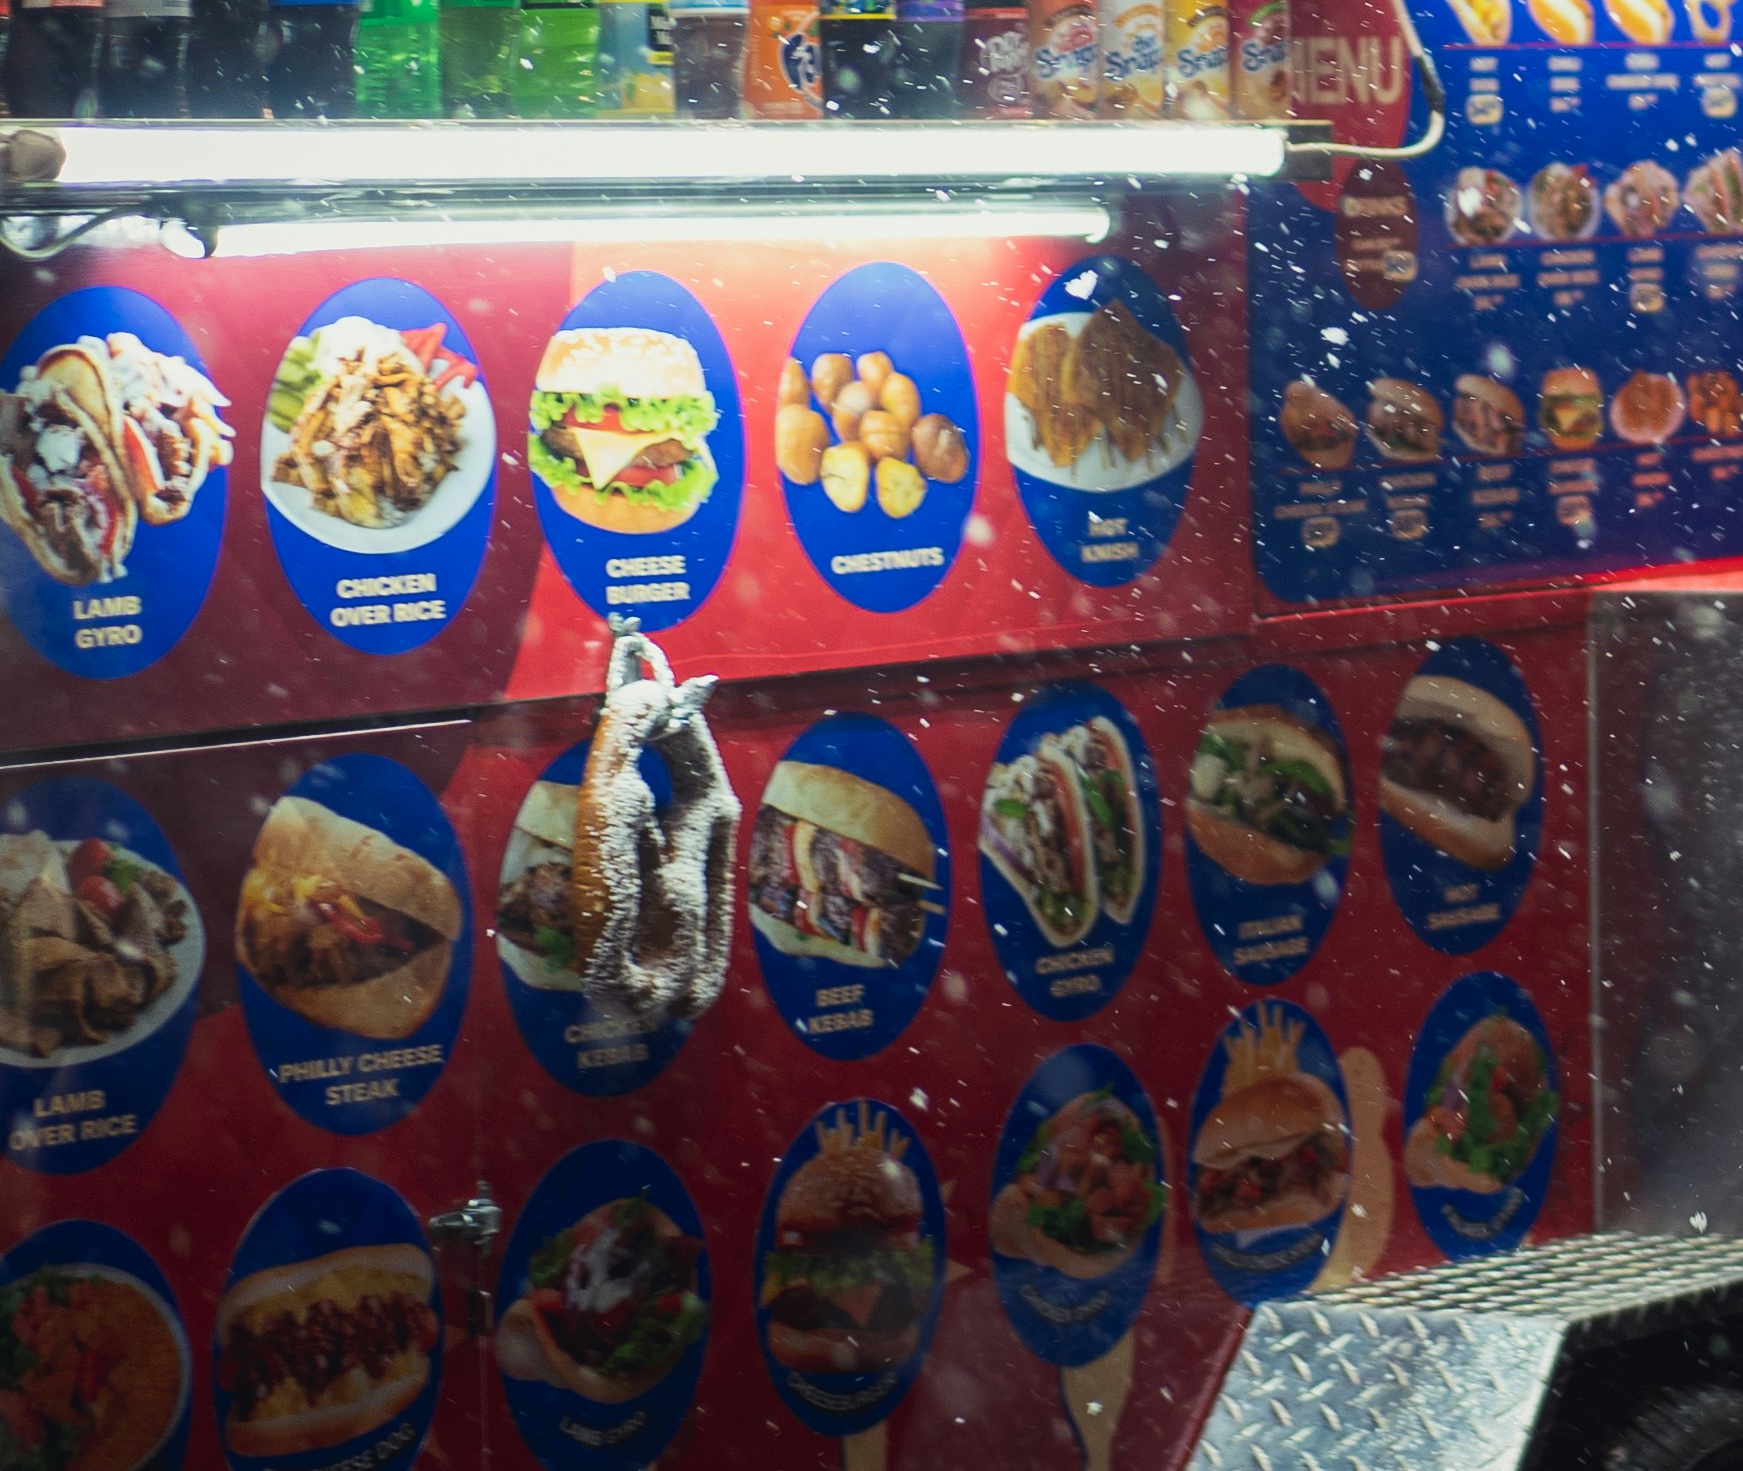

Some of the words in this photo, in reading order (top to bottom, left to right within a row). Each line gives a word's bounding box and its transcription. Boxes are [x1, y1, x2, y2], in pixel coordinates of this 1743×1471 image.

[606, 555, 686, 579] CHEESE
[831, 546, 945, 575] CHESTNUTS
[336, 571, 437, 599] CHICKEN
[606, 581, 690, 605] BURGER
[73, 596, 141, 620] LAMB
[330, 604, 390, 628] OVER
[393, 600, 446, 624] RICE
[75, 624, 142, 650] GYRO
[1035, 947, 1115, 976] CHICKEN
[815, 984, 864, 1008] BEEF
[807, 1008, 875, 1034] KEBAB
[279, 1056, 354, 1083] PHILLY
[357, 1044, 444, 1073] CHEESE
[576, 1043, 650, 1070] KEBAB
[33, 1089, 106, 1118] LAMB
[324, 1078, 400, 1106] STEAK
[8, 1123, 76, 1151] OVER
[80, 1114, 138, 1141] RICE
